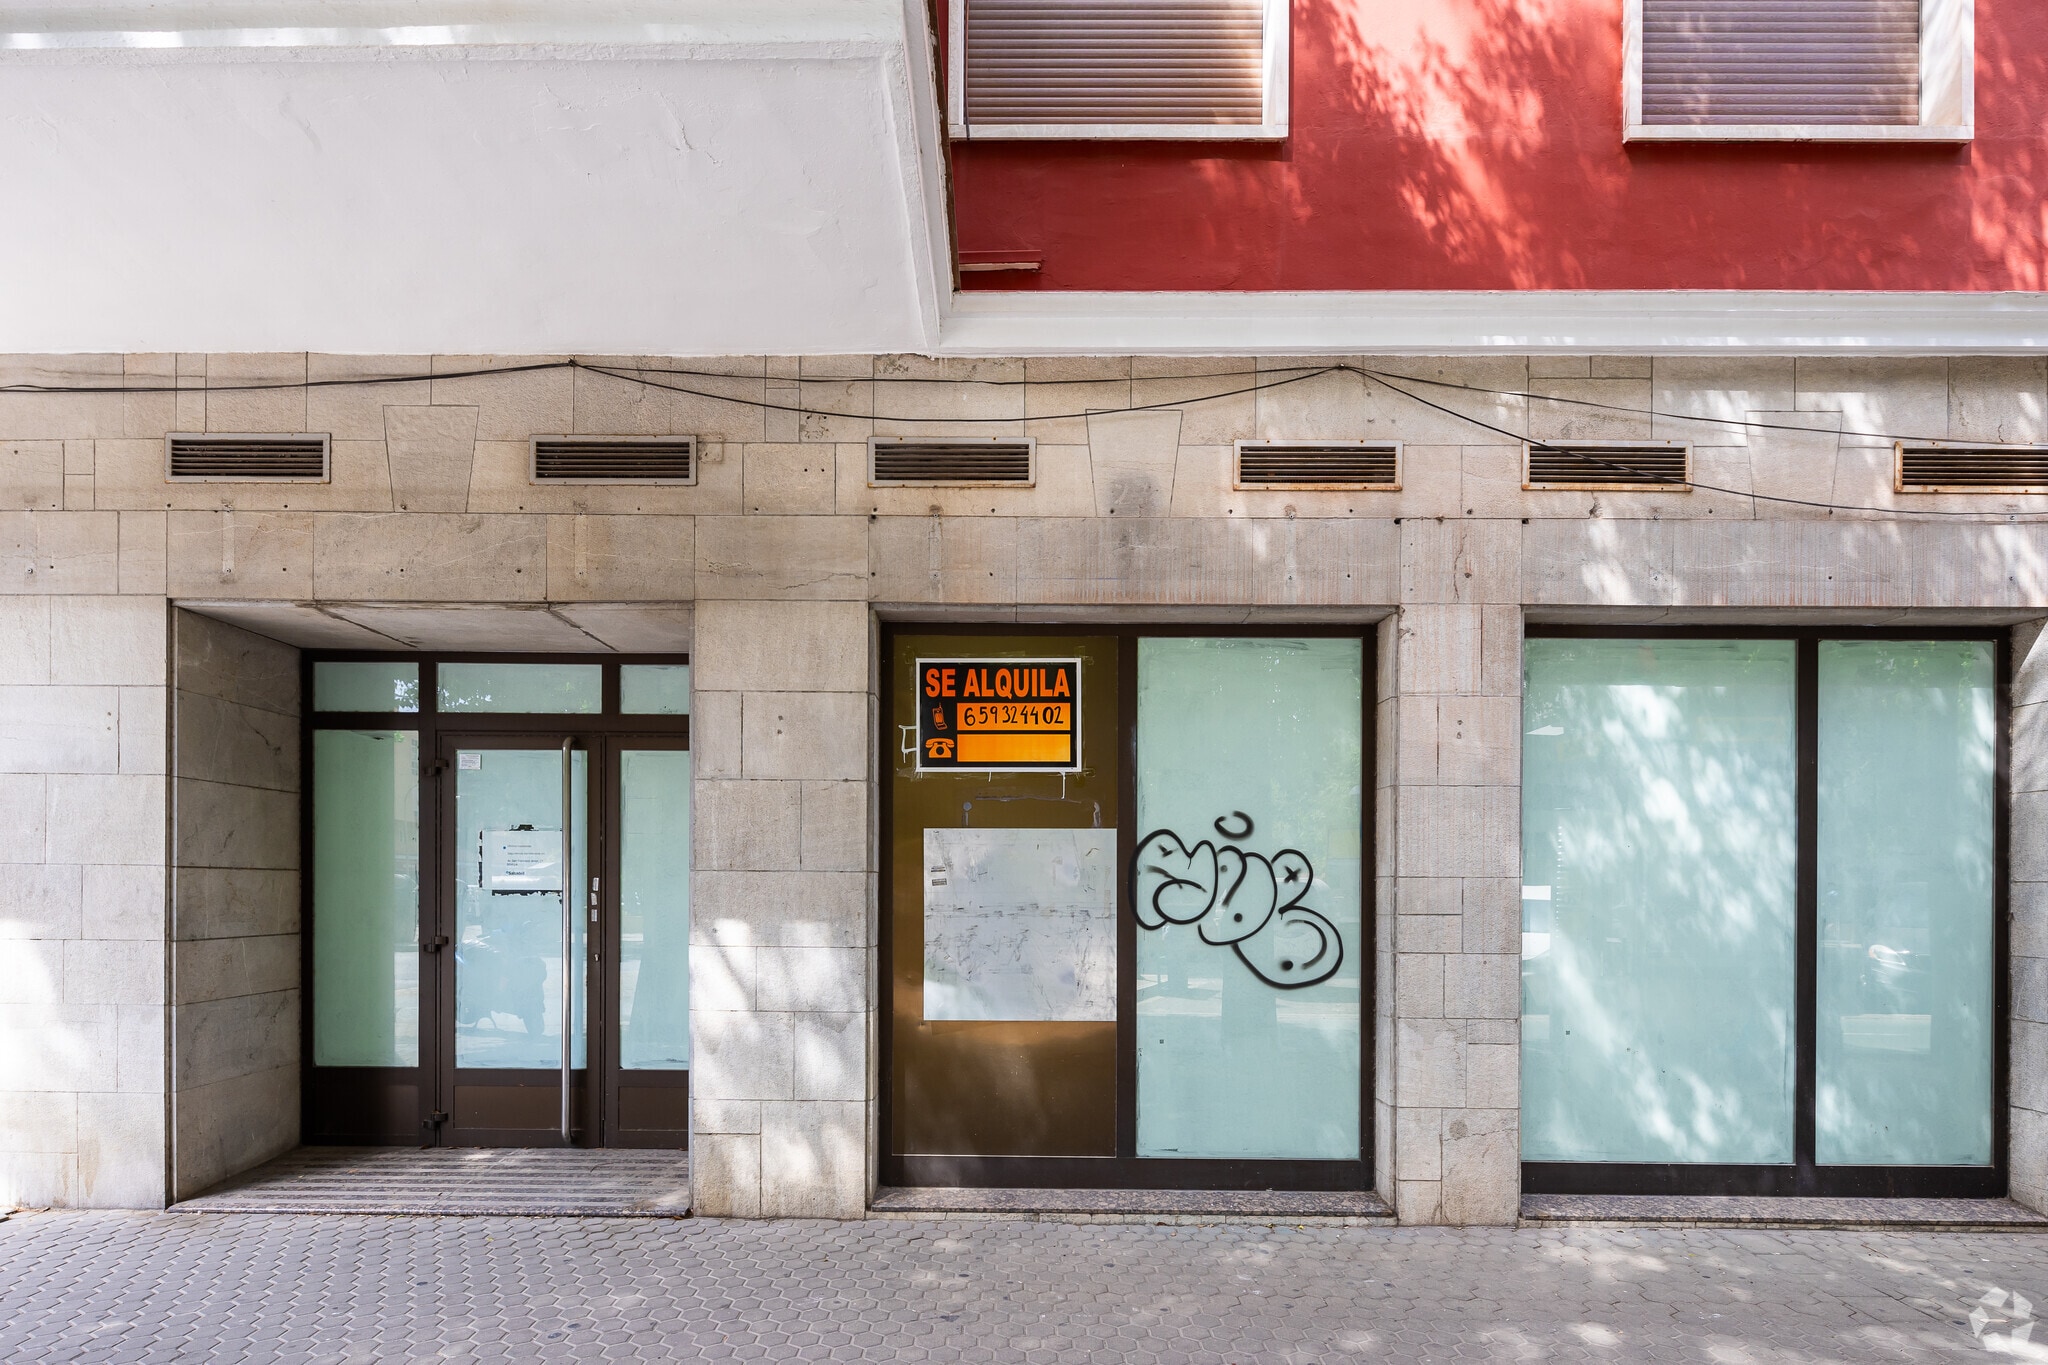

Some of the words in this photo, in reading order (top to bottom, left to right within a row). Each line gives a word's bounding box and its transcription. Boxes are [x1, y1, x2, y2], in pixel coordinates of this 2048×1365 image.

[925, 668, 956, 698] SE
[963, 668, 1071, 700] ALQUILA
[964, 705, 1064, 727] 659324402
